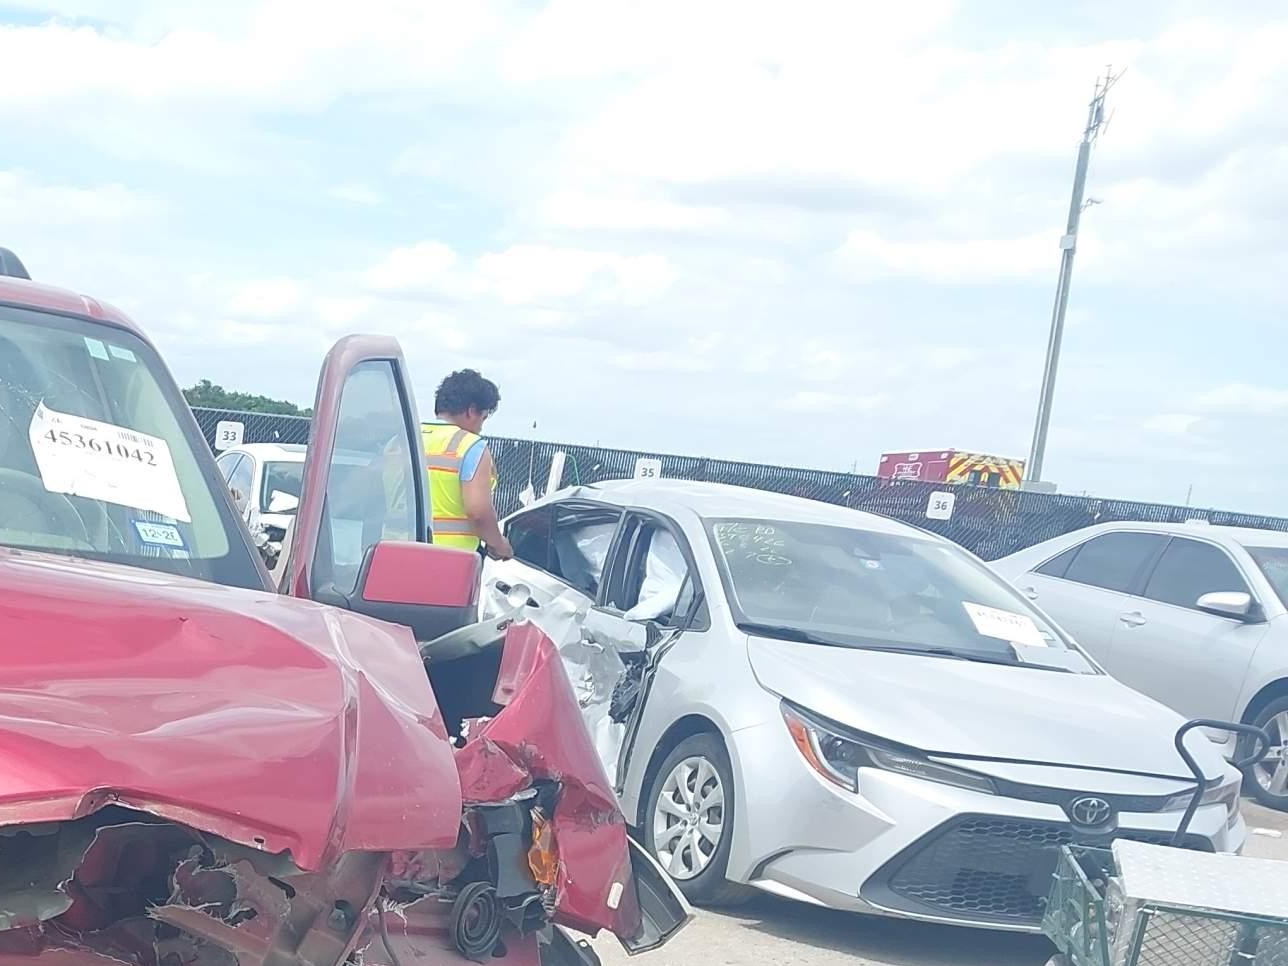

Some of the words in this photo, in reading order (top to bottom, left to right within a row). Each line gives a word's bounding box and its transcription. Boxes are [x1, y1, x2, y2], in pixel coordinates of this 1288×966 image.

[222, 430, 237, 441] 33
[43, 428, 158, 467] 45361042
[641, 467, 655, 478] 35
[934, 500, 948, 511] 36
